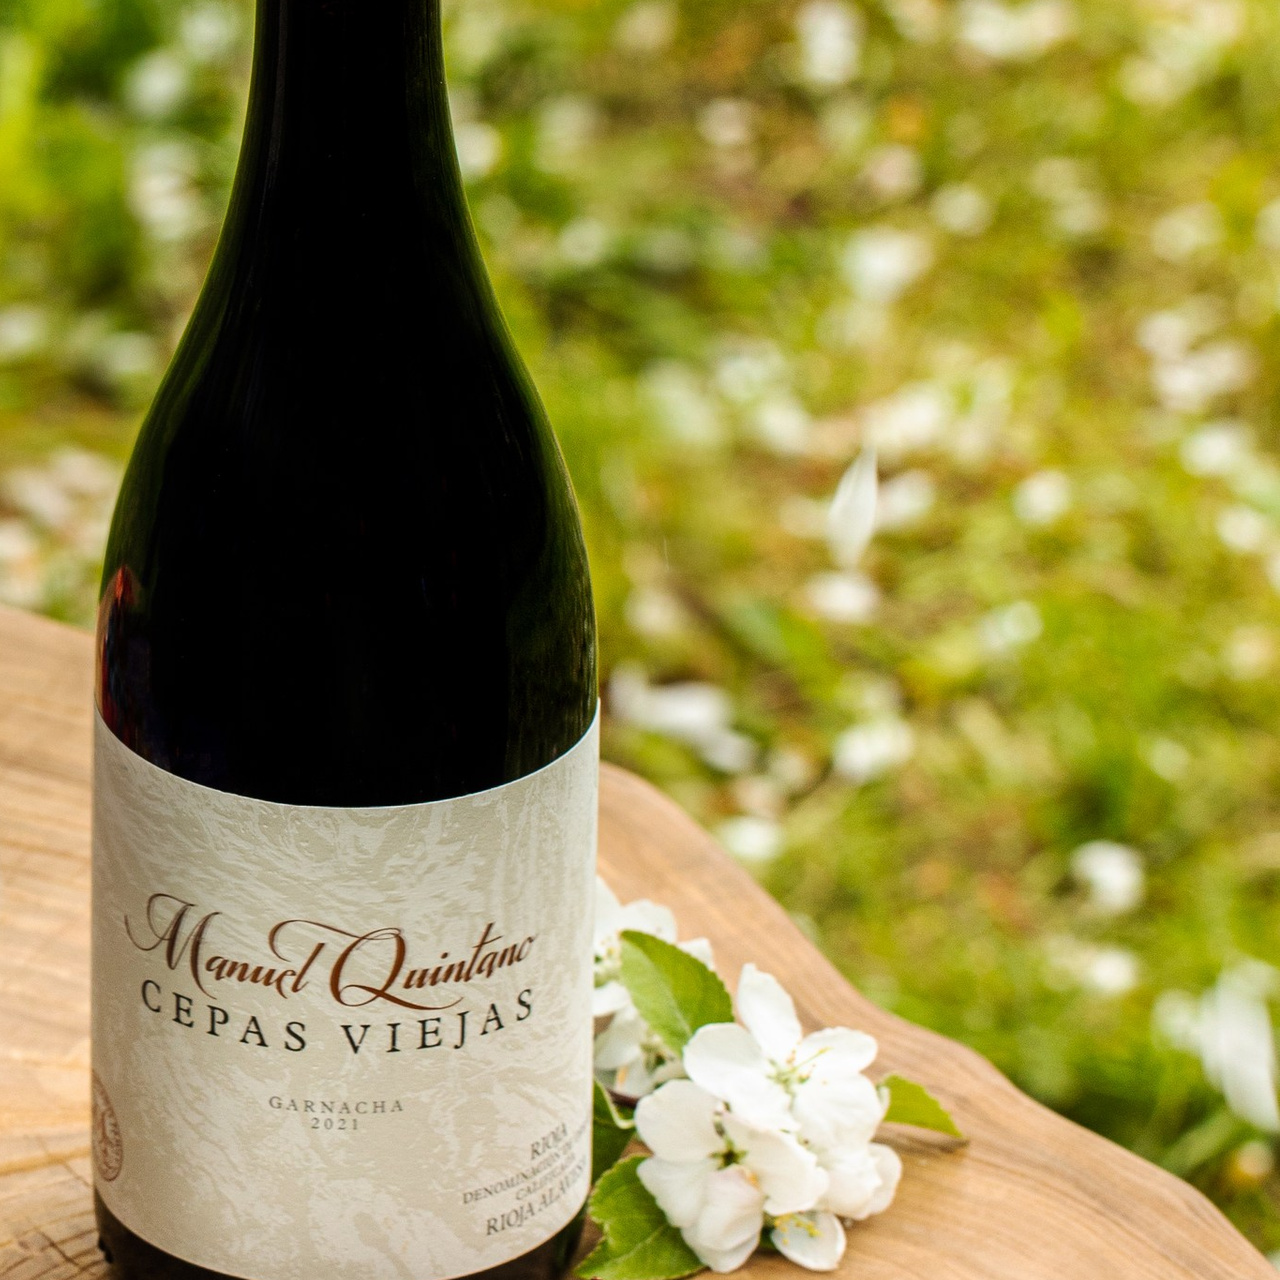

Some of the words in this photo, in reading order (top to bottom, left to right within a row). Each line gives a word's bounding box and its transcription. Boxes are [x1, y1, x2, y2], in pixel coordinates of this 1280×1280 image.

[124, 892, 326, 1000] Manuel
[268, 919, 539, 1011] Quintano
[141, 979, 307, 1053] CEPAS
[339, 988, 533, 1055] VIEJAS
[268, 1095, 405, 1114] GARNACHA
[311, 1117, 360, 1131] 2021
[485, 1202, 536, 1236] RIOJA
